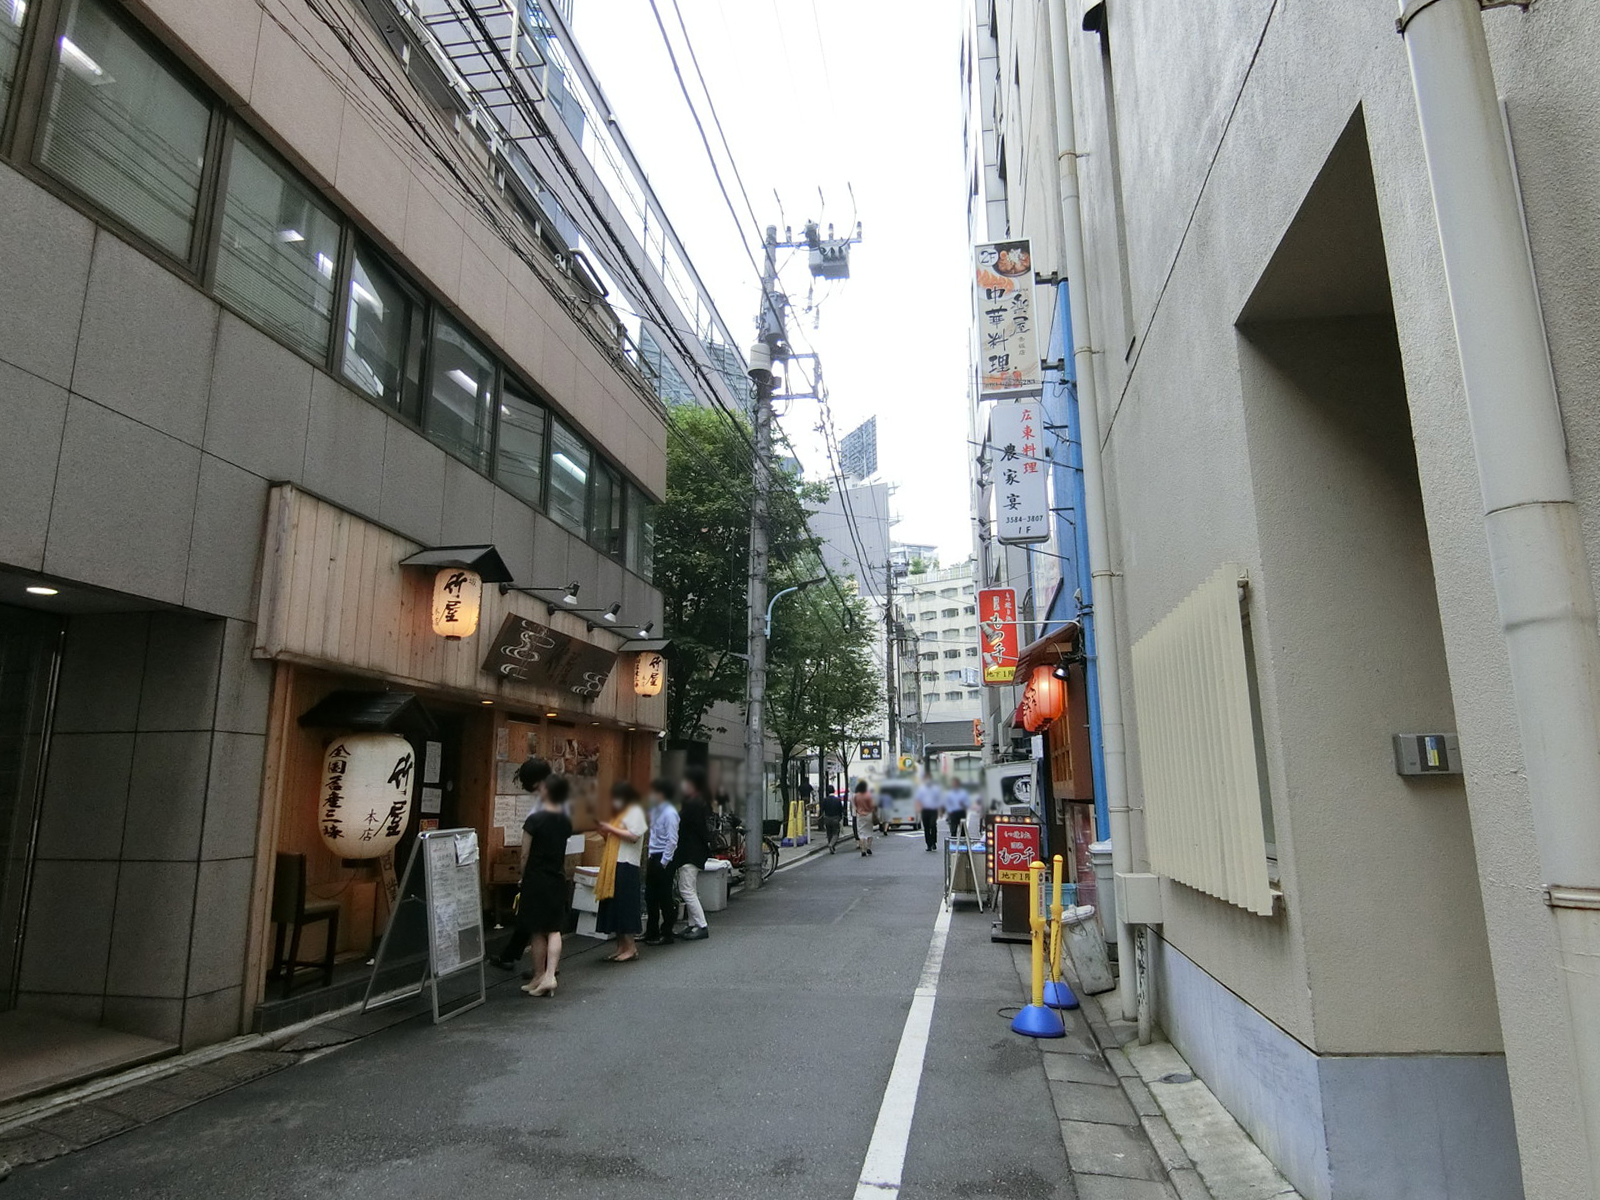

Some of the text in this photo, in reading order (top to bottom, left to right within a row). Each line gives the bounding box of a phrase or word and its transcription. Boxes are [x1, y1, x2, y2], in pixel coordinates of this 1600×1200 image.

[980, 250, 997, 264] 2F
[985, 286, 1010, 374] 中華料理
[1021, 408, 1039, 474] 広東料理
[1000, 443, 1022, 511] 農家宴
[1005, 515, 1044, 524] 3584-3807
[359, 808, 379, 842] 本店
[998, 846, 1035, 868] もつ千
